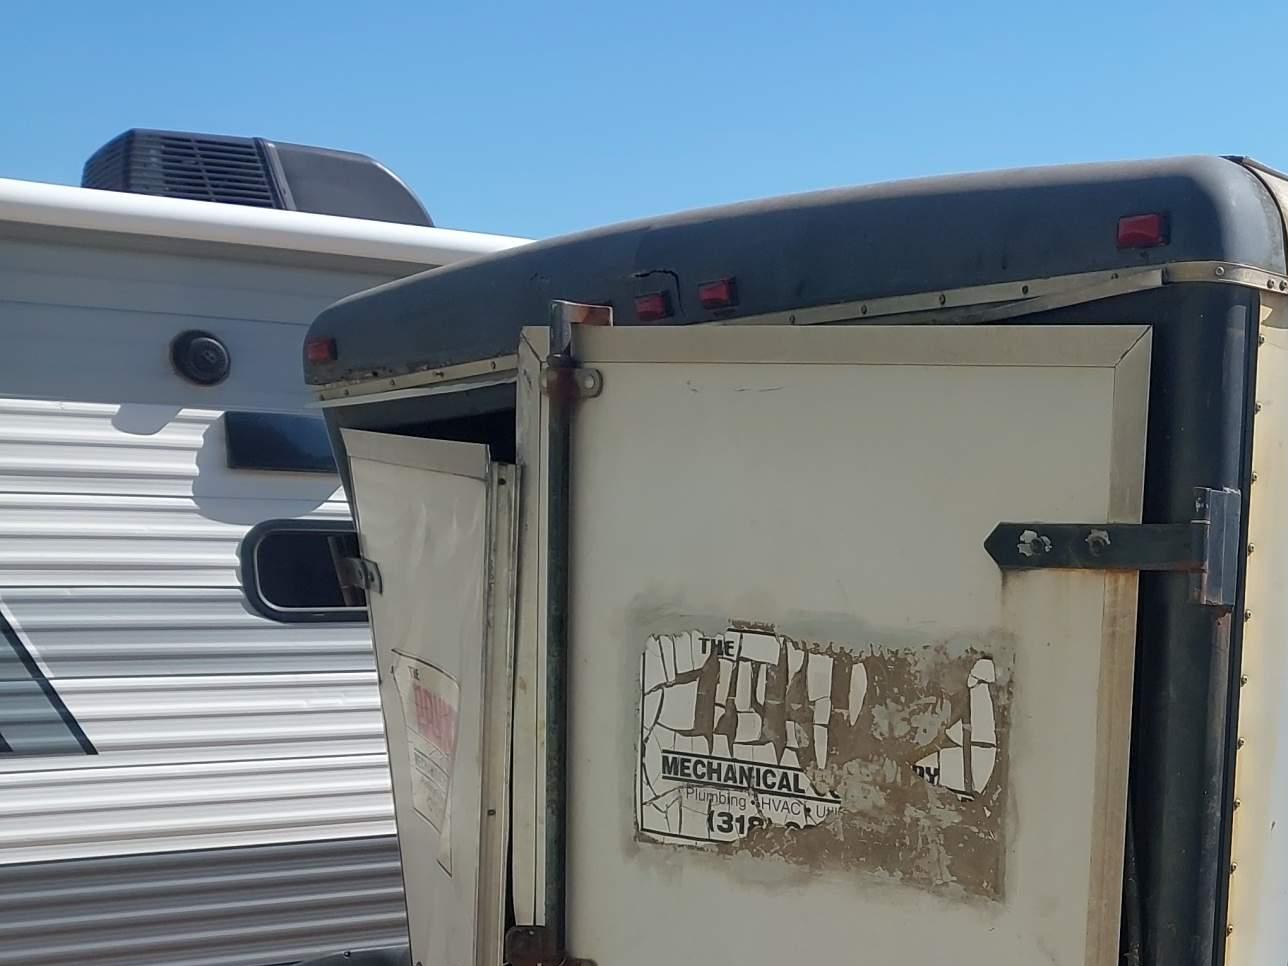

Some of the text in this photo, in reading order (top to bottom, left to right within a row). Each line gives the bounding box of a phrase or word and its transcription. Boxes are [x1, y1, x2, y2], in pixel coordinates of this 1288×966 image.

[698, 637, 734, 657] THE
[661, 755, 806, 794] MECHANICAL
[685, 786, 747, 811] Plumbing
[761, 799, 801, 816] HVAC
